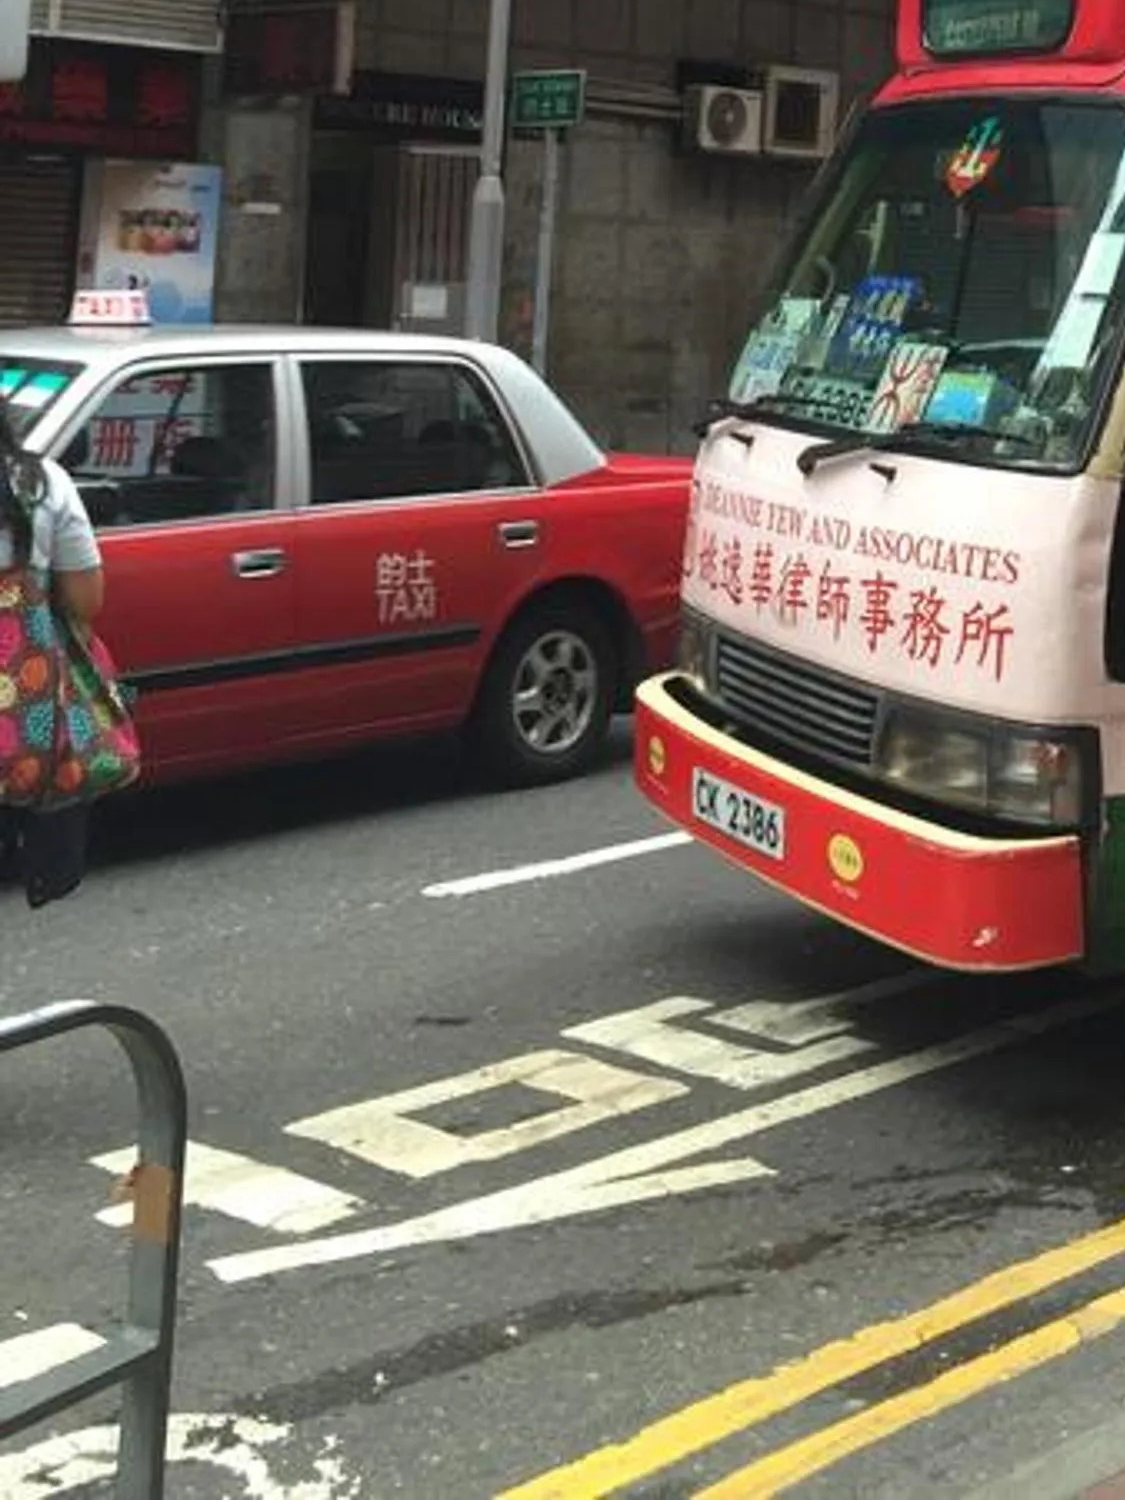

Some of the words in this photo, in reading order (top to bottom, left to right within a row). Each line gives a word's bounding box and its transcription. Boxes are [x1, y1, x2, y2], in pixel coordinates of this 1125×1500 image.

[376, 548, 435, 587] 的士
[806, 515, 852, 551] AND
[851, 523, 1022, 585] ASSOCIATES
[374, 586, 437, 624] TAXI
[696, 777, 721, 821] CK
[726, 791, 778, 849] 2386
